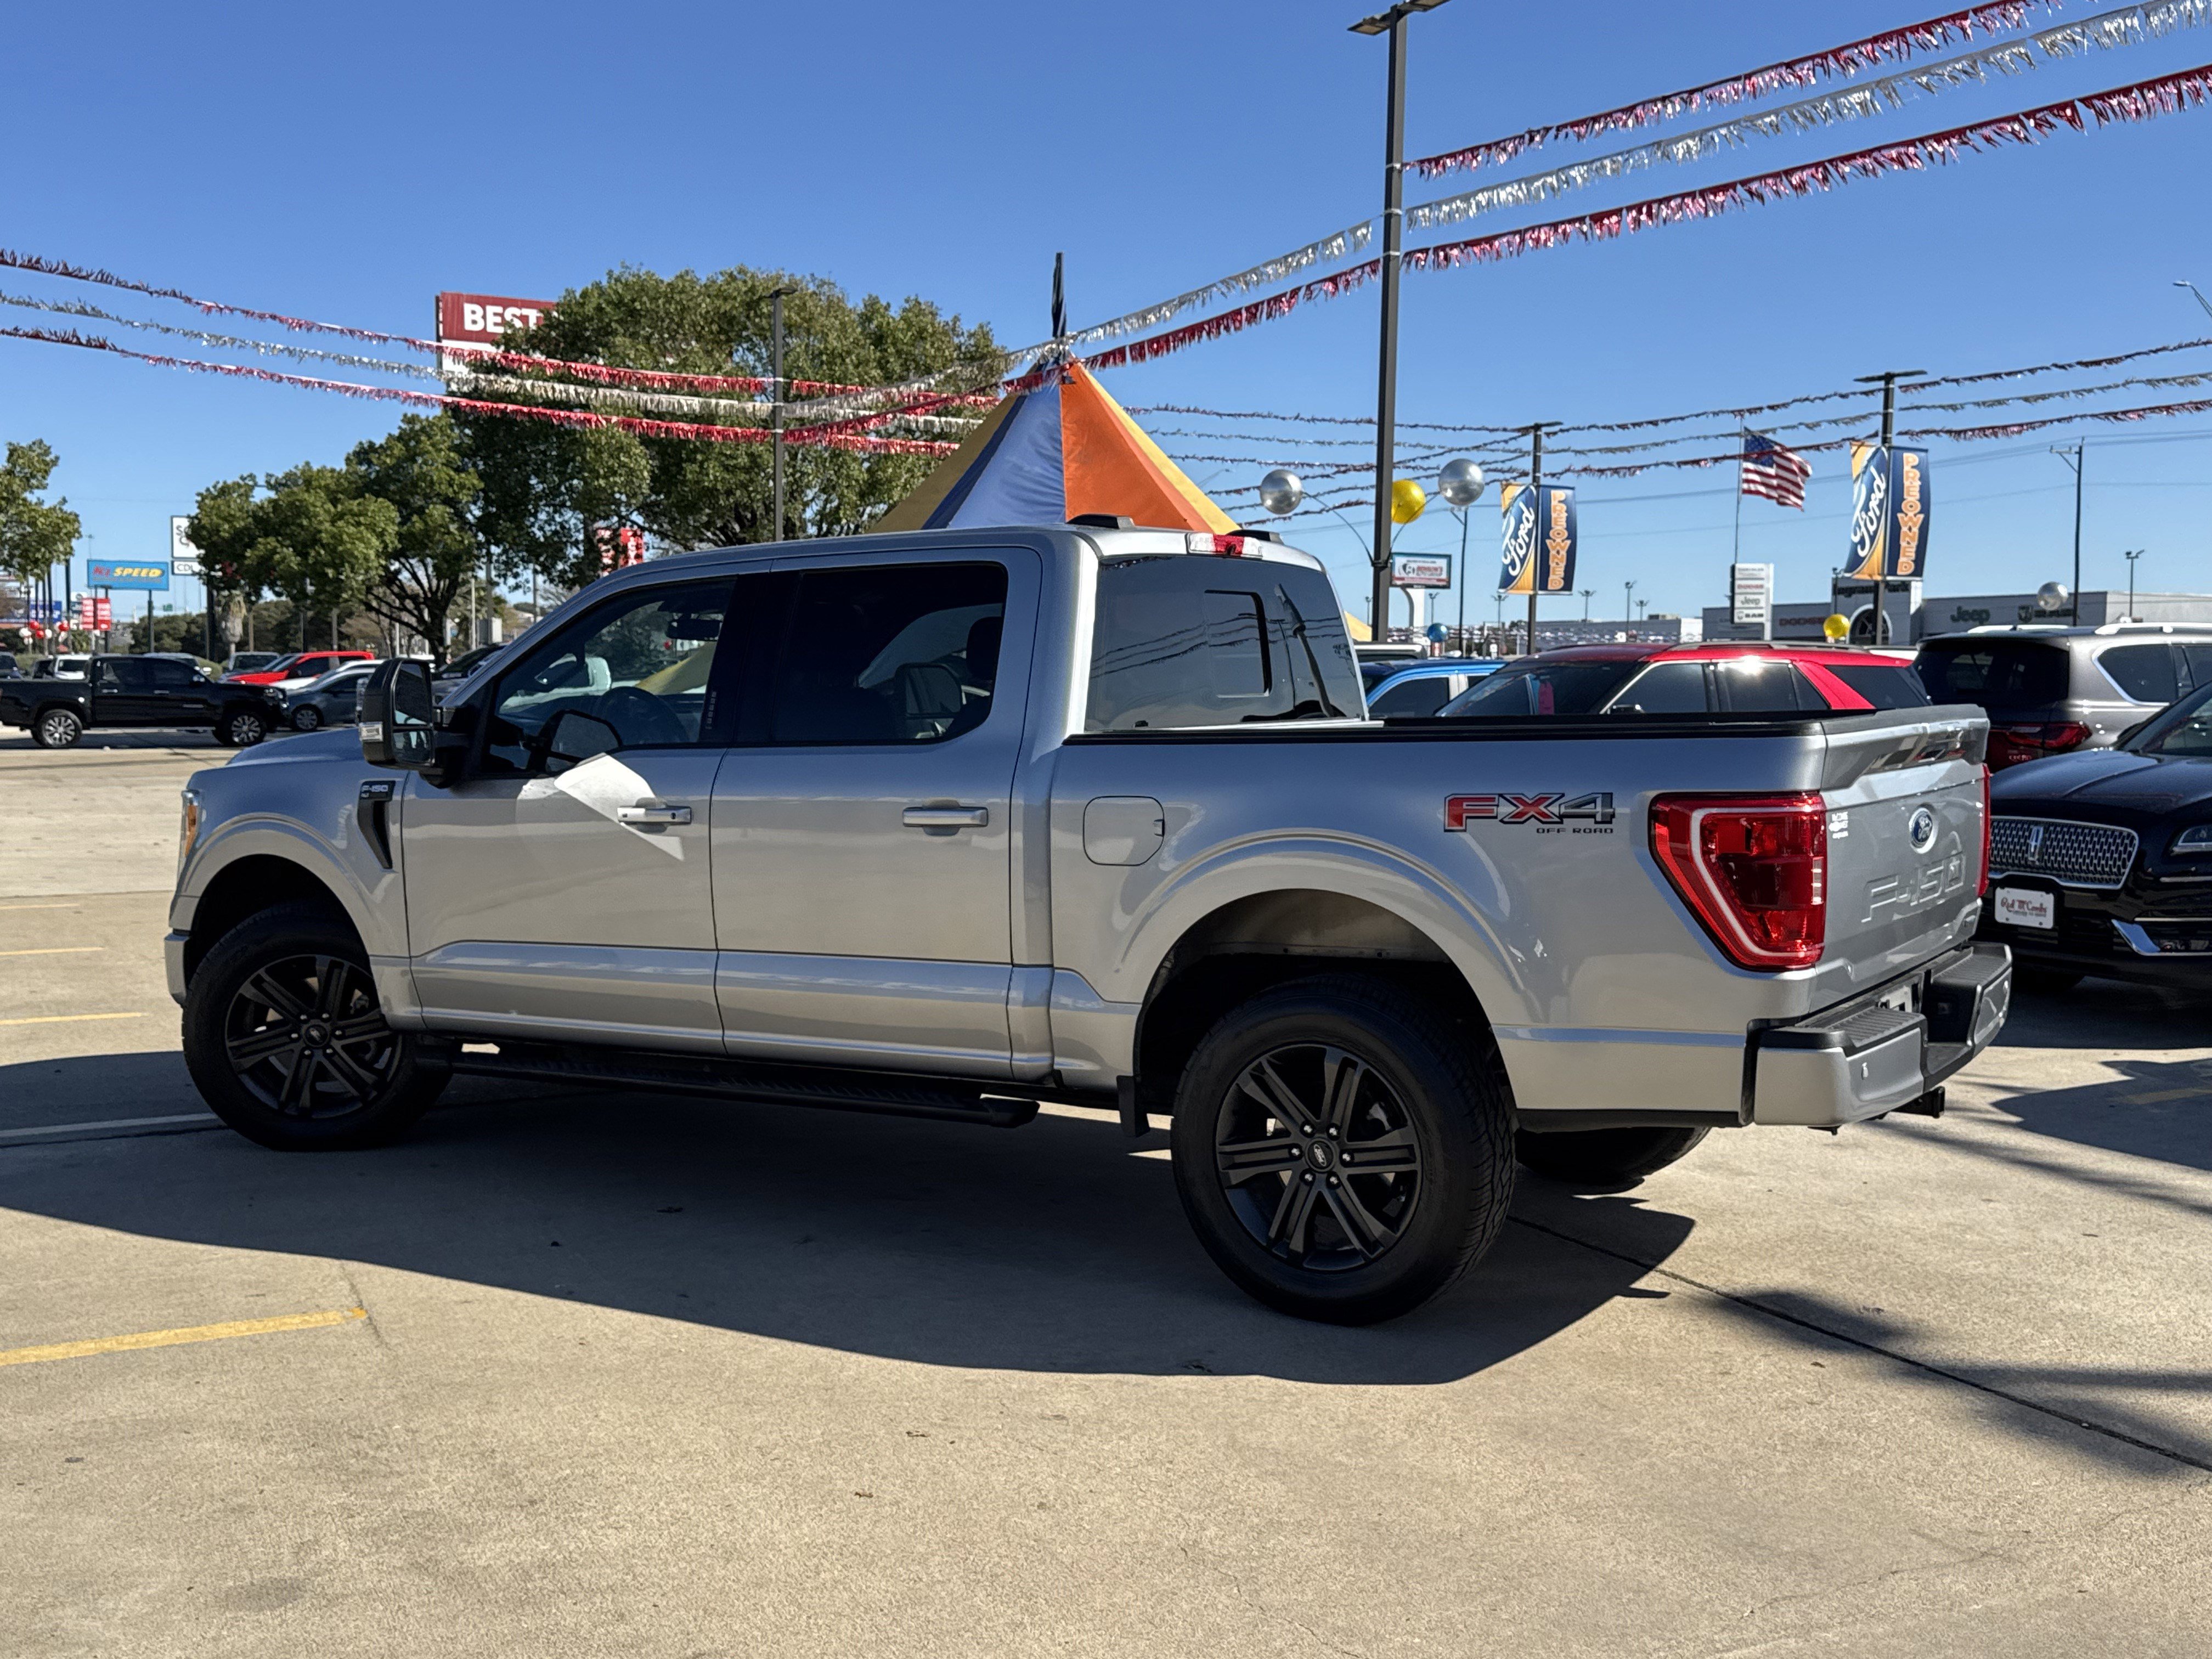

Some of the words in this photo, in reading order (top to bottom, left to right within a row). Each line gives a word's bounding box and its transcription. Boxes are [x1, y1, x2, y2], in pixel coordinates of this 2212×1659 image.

[464, 302, 544, 334] BEST
[1502, 501, 1534, 576] Ford
[1545, 489, 1571, 590] PREOWNED
[1851, 465, 1886, 557] Ford
[1897, 453, 1925, 575] PREOWNED
[113, 567, 163, 577] SPEED
[1950, 606, 1991, 625] Jeep
[1444, 792, 1616, 832] FX4
